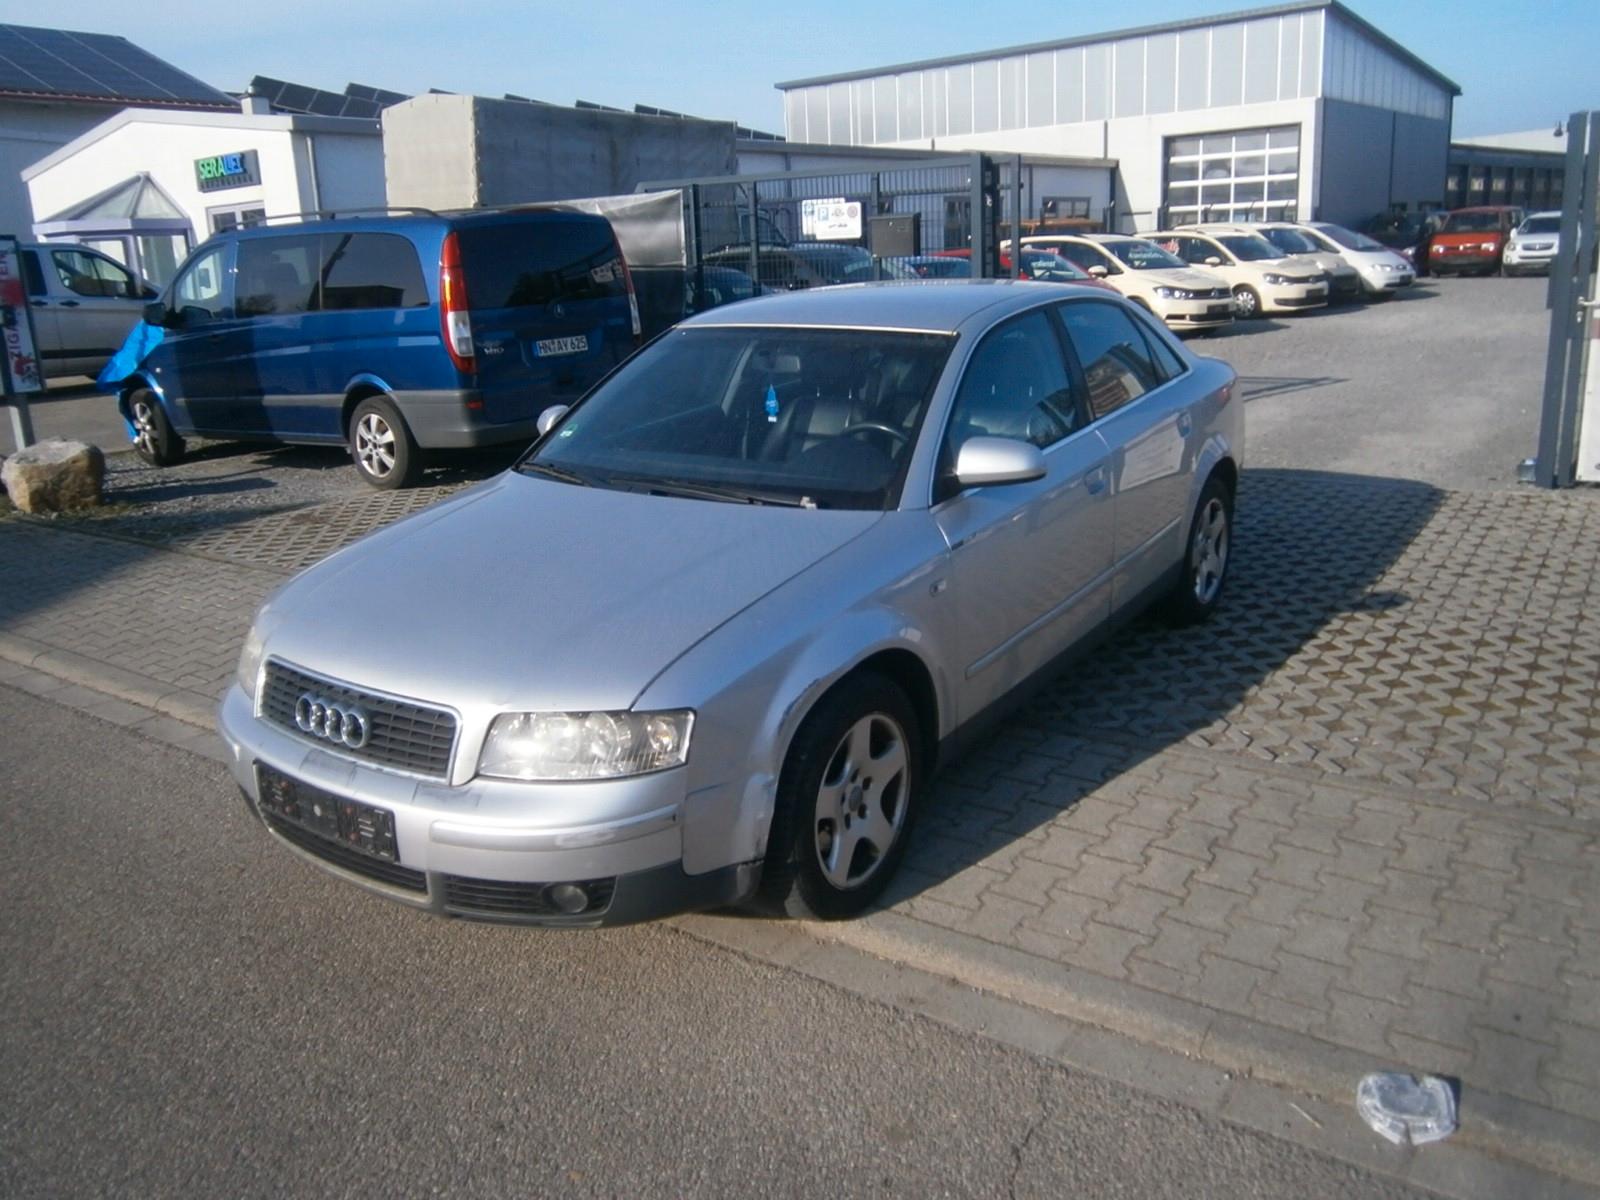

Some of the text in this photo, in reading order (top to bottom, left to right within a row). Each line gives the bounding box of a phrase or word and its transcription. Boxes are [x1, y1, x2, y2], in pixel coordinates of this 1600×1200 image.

[539, 336, 587, 354] HN AY 625
